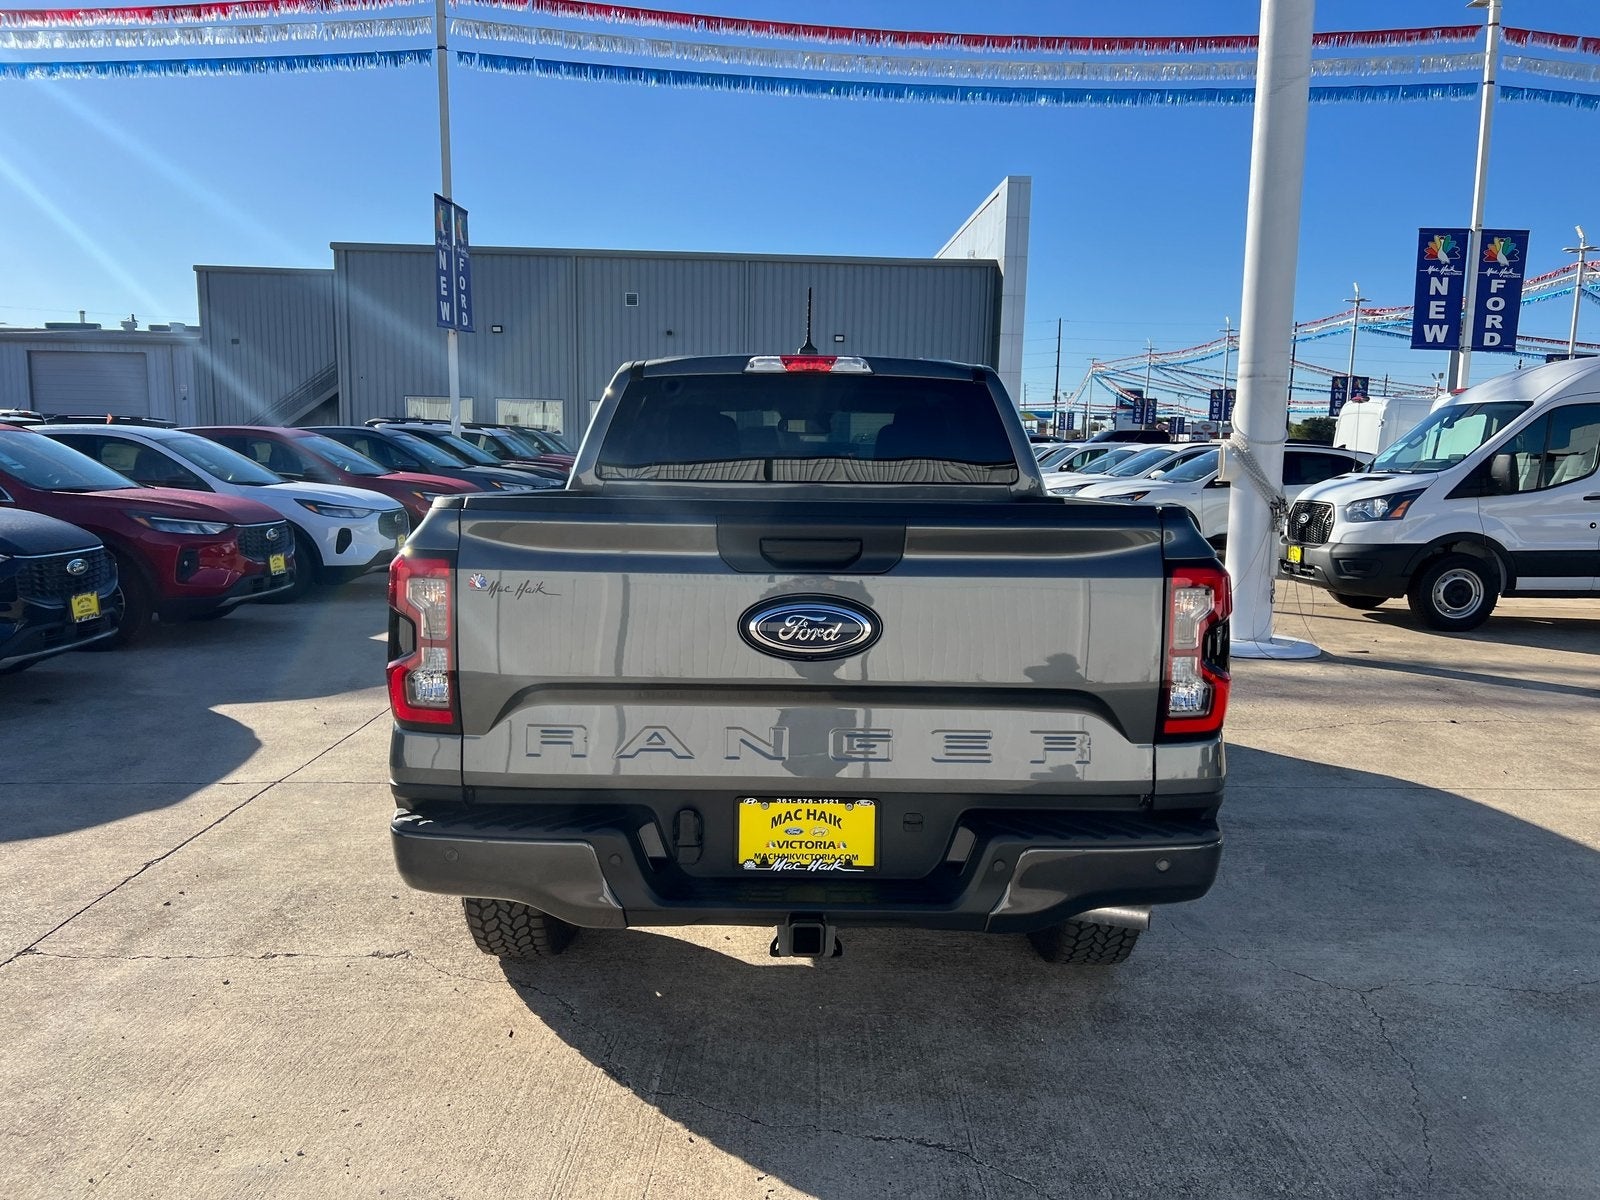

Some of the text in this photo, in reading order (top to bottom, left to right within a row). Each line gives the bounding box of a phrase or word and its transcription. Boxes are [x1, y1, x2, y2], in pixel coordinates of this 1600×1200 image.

[439, 249, 450, 322] NEW
[458, 257, 469, 326] FORD
[1423, 276, 1449, 343] NEW
[1483, 279, 1506, 347] FORD
[487, 579, 555, 600] Mac Haik
[778, 615, 842, 641] Ford
[525, 723, 1092, 764] RANGER
[771, 808, 842, 830] MAC HAIK
[776, 840, 836, 850] VICTORIA
[770, 859, 853, 872] Mac Haik
